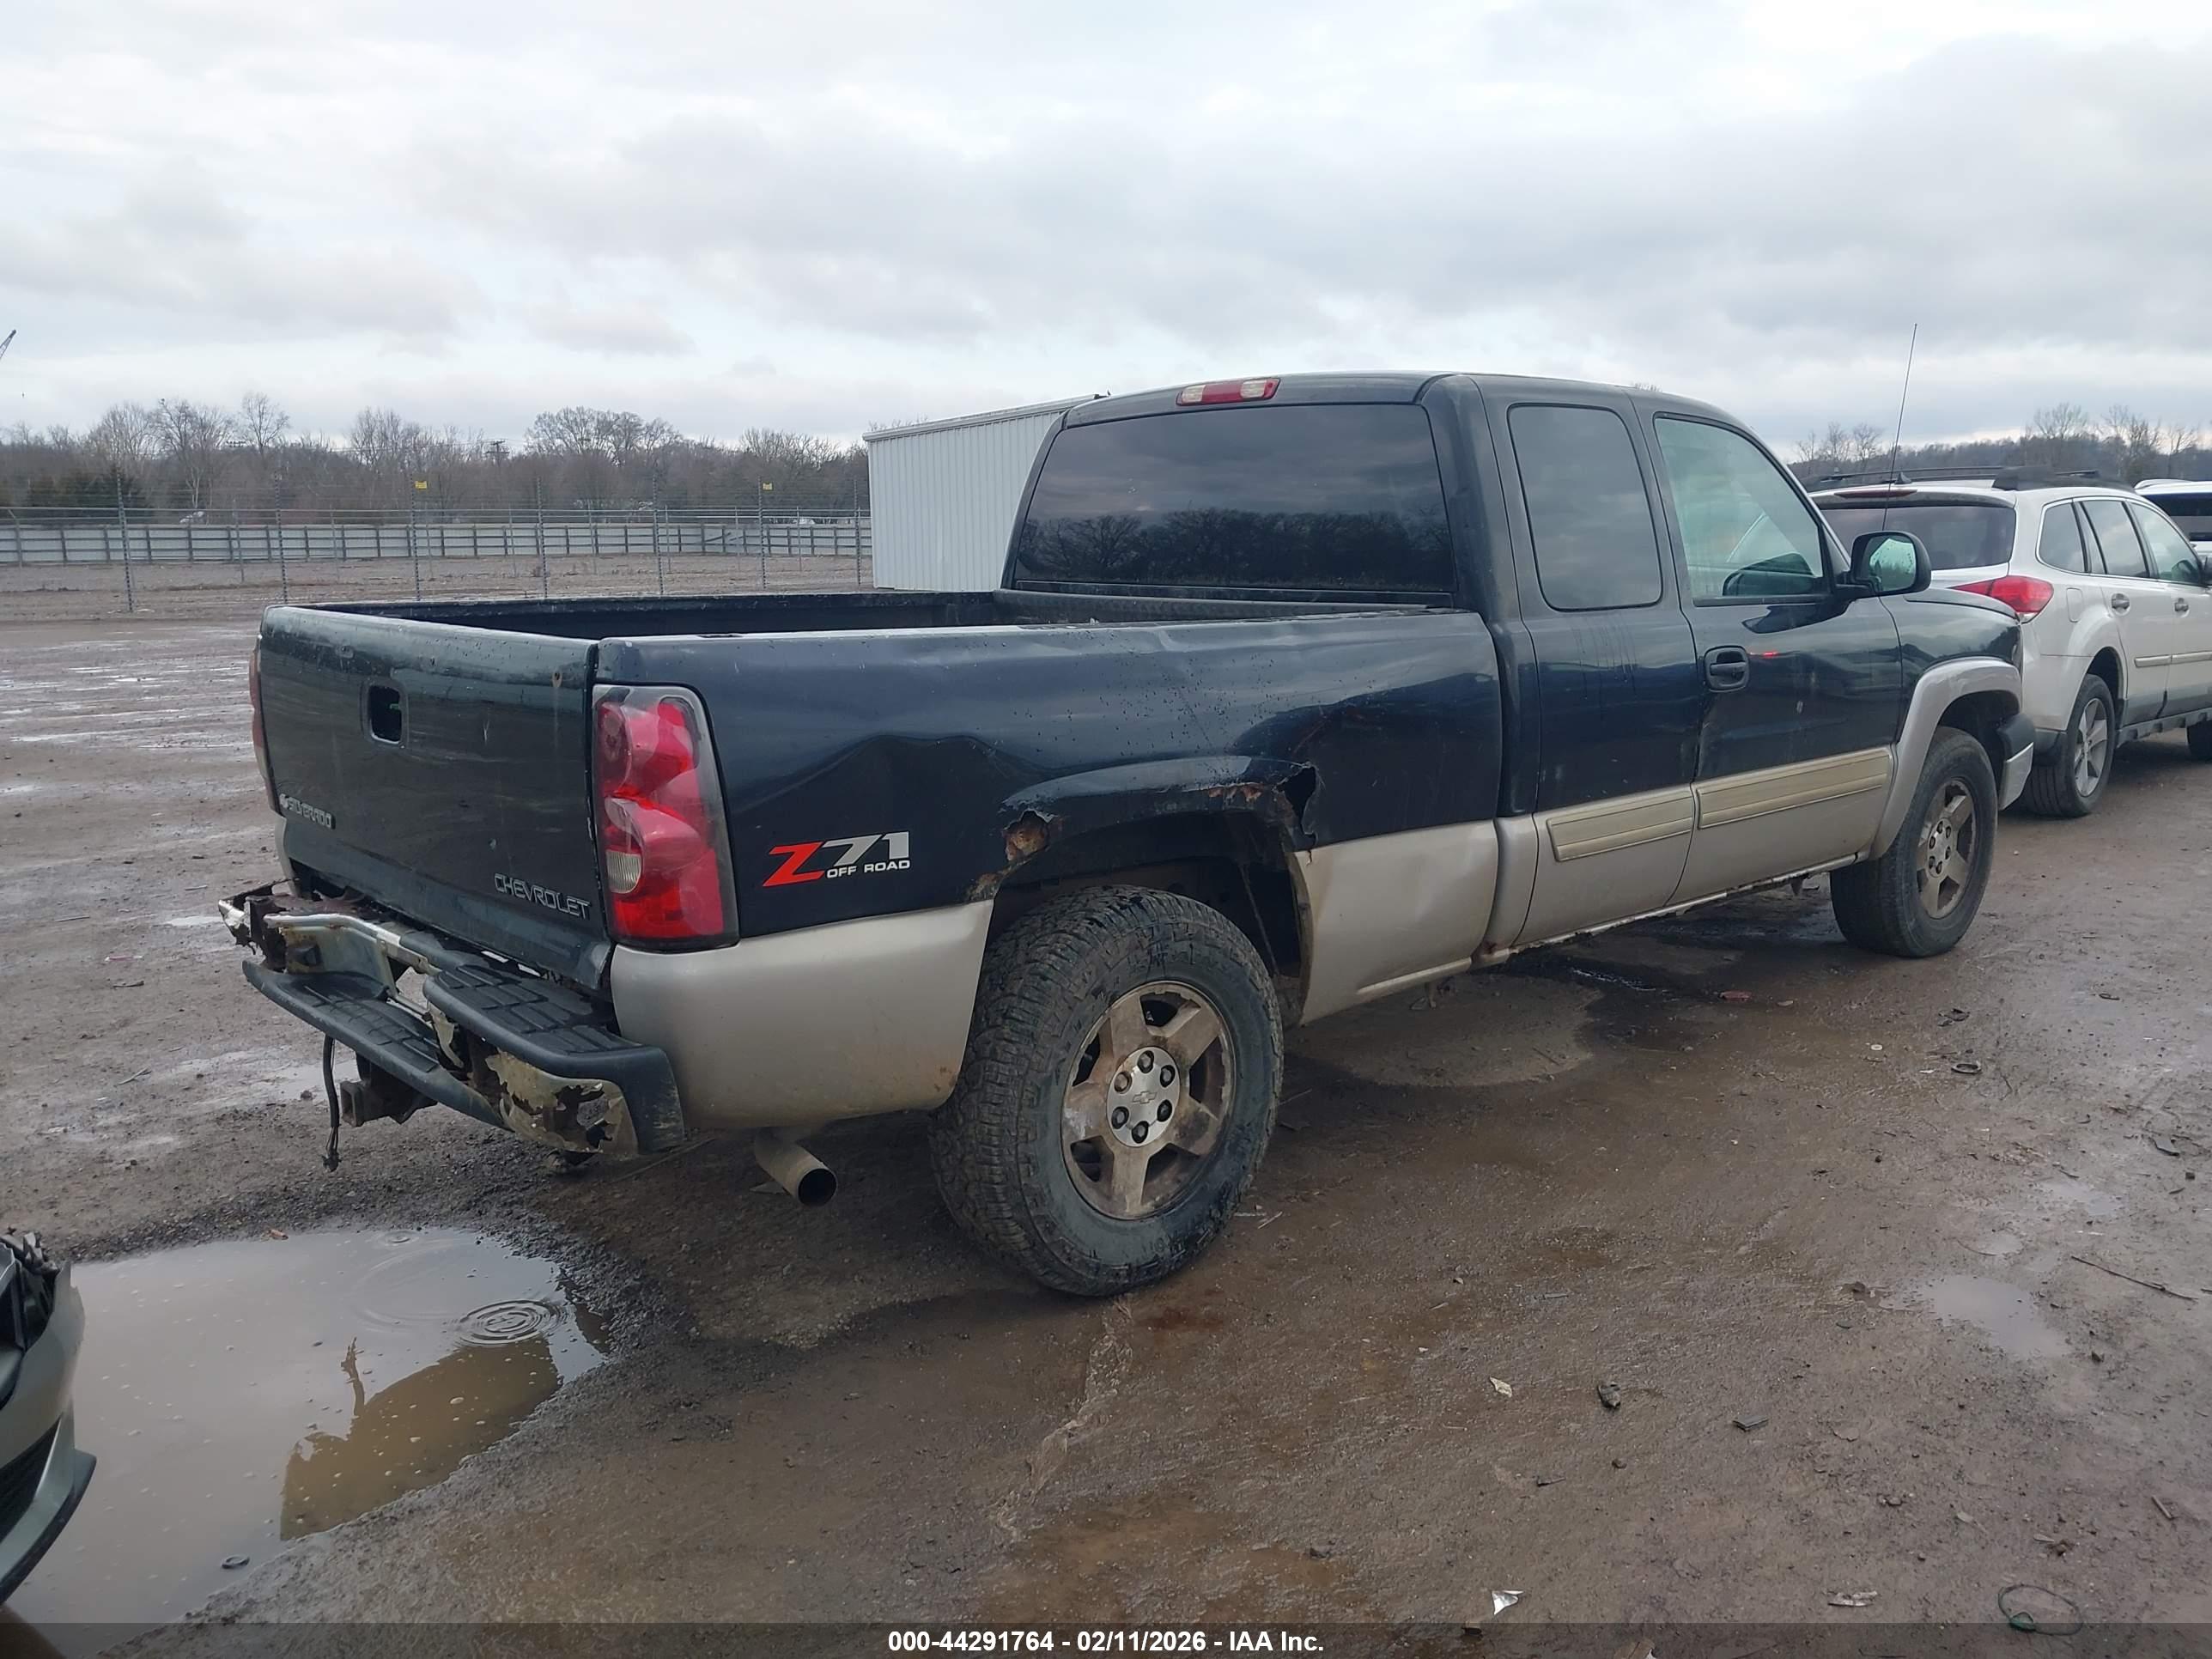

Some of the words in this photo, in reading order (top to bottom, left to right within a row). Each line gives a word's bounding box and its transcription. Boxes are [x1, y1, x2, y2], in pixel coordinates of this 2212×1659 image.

[763, 831, 909, 887] Z71
[826, 866, 857, 878] OFF
[864, 860, 910, 873] ROAD
[494, 872, 591, 920] CHEVROLET
